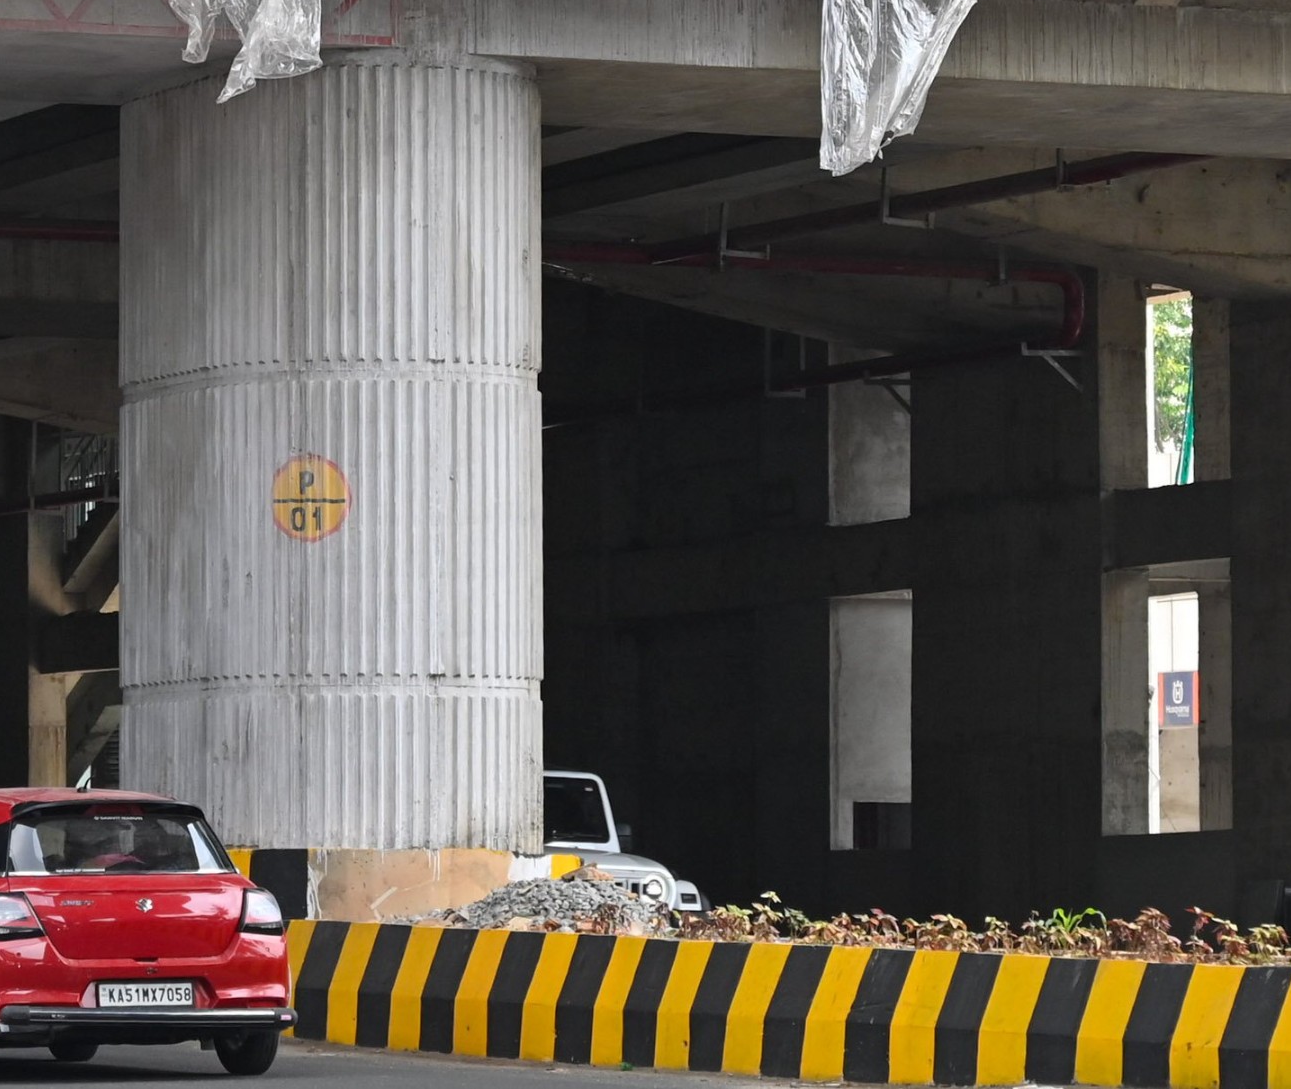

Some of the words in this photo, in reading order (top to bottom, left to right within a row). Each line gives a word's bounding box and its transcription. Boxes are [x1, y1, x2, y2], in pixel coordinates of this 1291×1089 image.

[299, 471, 314, 495] P
[291, 506, 321, 532] 01
[108, 987, 192, 1003] KA51MX7058
